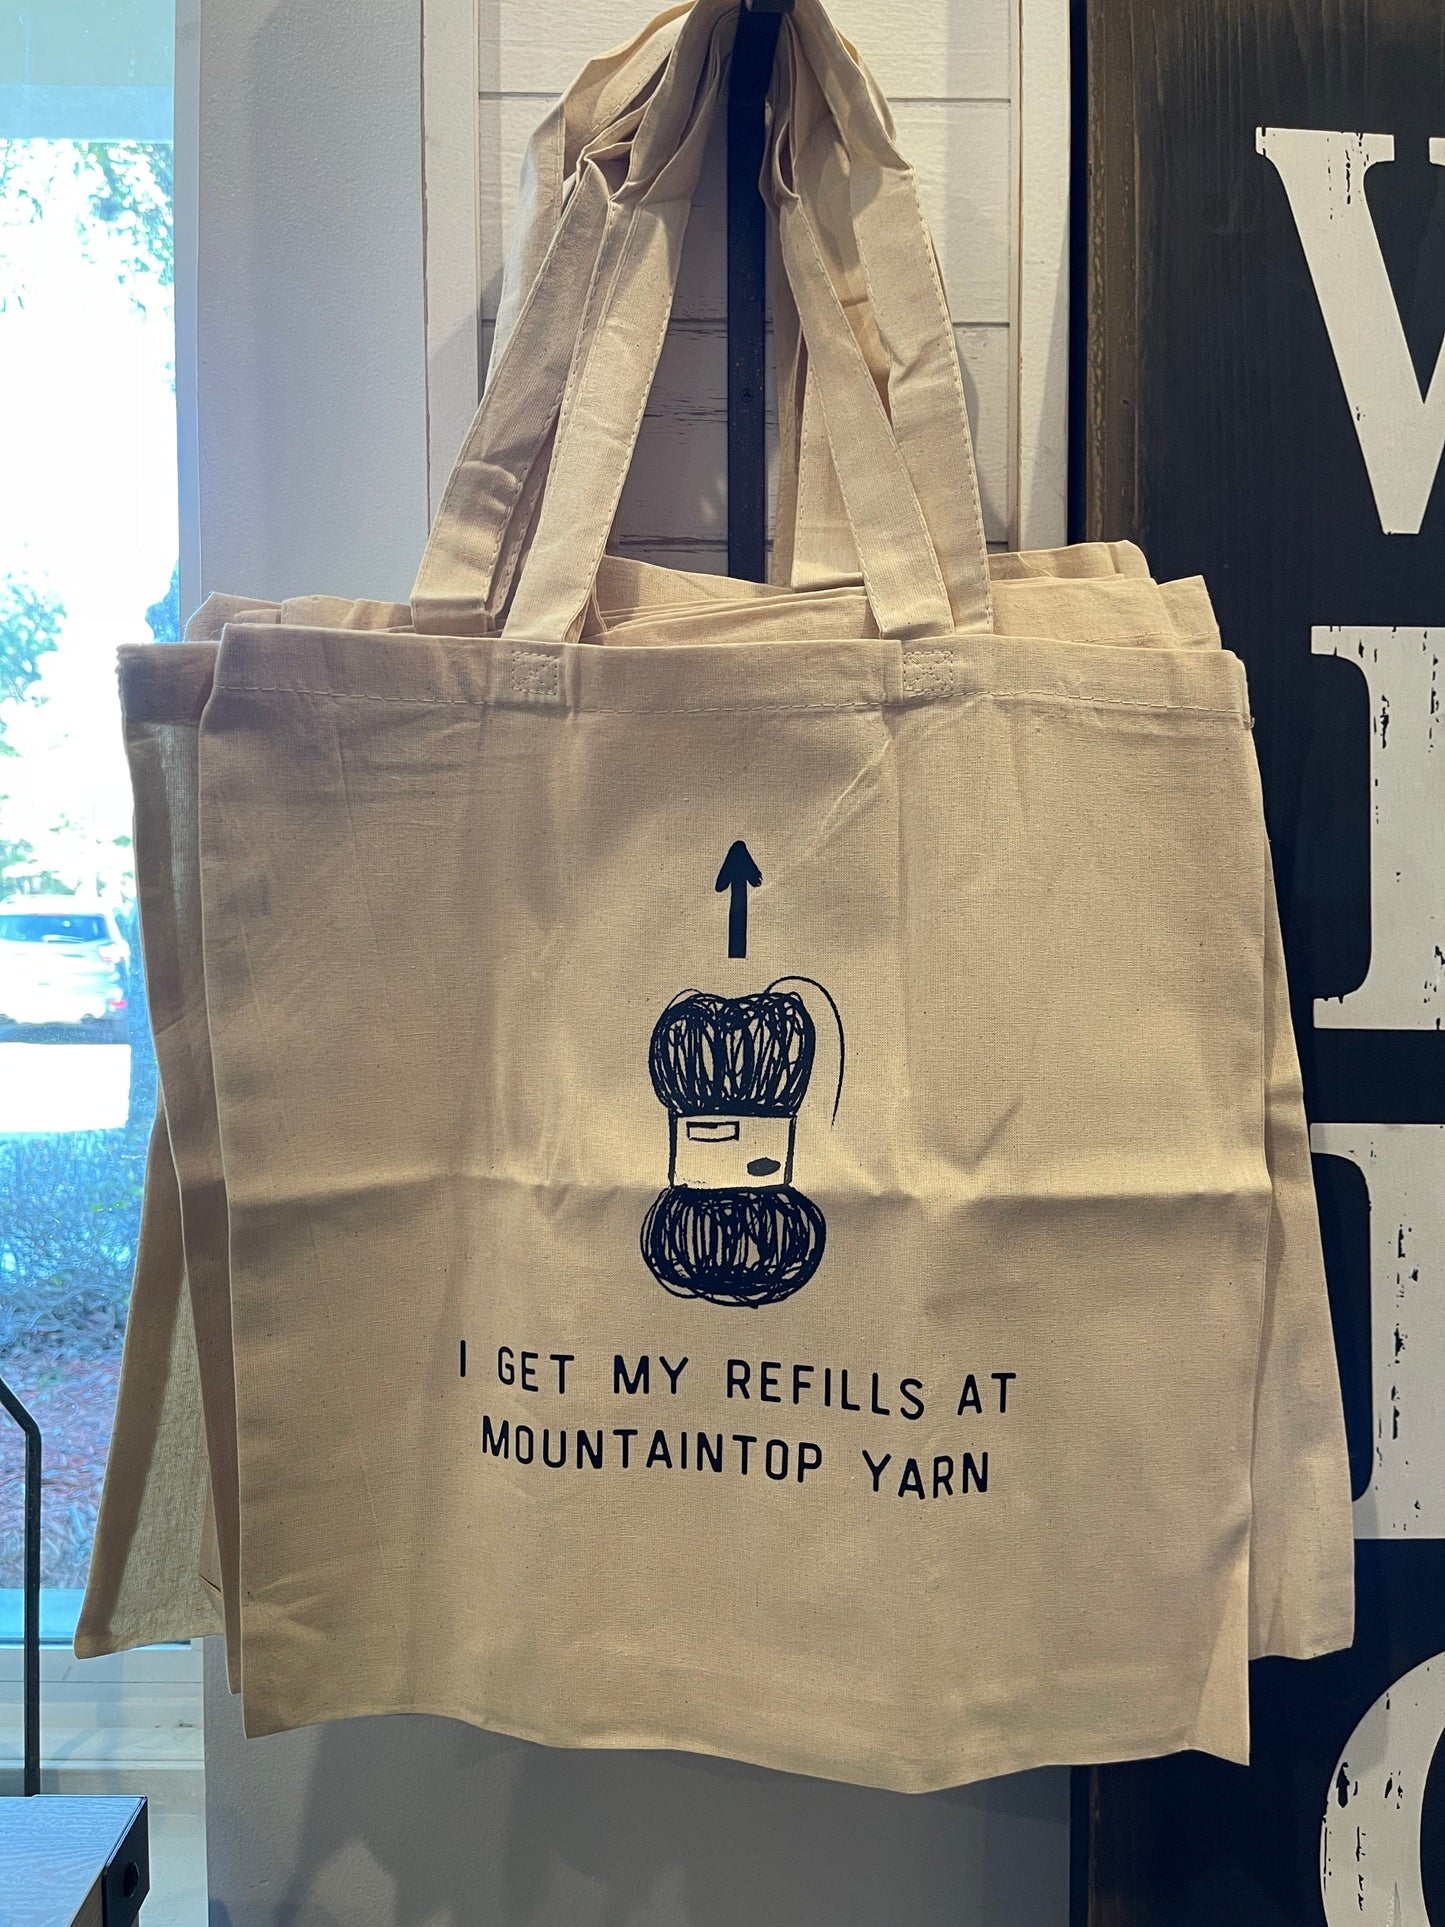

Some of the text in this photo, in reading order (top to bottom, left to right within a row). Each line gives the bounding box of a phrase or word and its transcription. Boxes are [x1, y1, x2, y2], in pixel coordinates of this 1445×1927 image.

[459, 1339, 1017, 1421] I GET MY REFILLS AT
[482, 1415, 989, 1501] MOUNTAINTOP YARN
